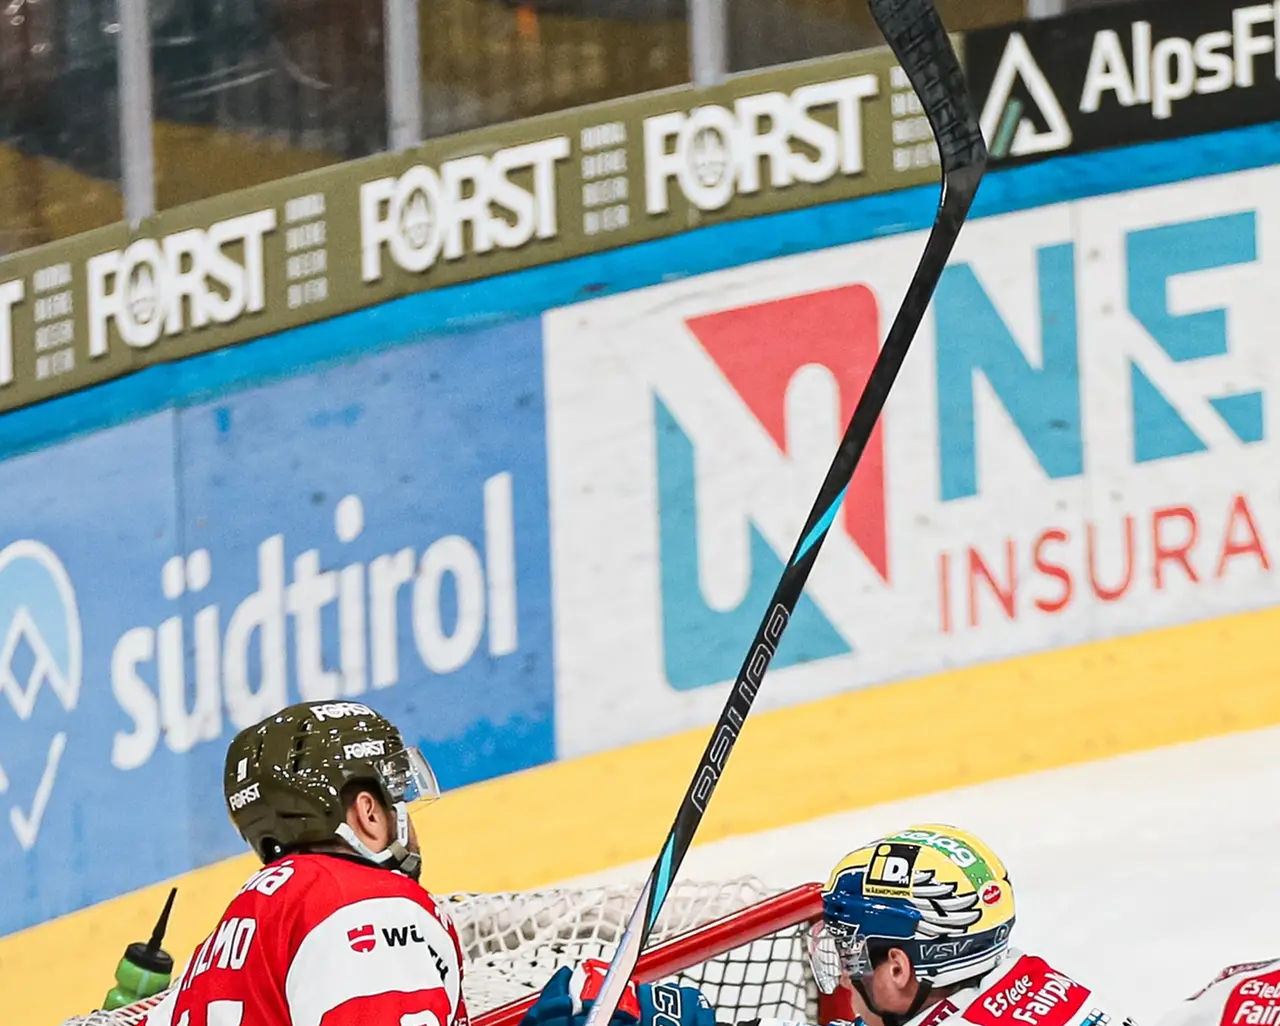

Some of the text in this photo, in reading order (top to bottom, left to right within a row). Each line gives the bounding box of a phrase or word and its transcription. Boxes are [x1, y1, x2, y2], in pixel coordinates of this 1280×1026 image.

[361, 137, 570, 283] FORST
[644, 74, 878, 215] FORST
[87, 209, 277, 359] FORST
[110, 471, 518, 770] südtirol
